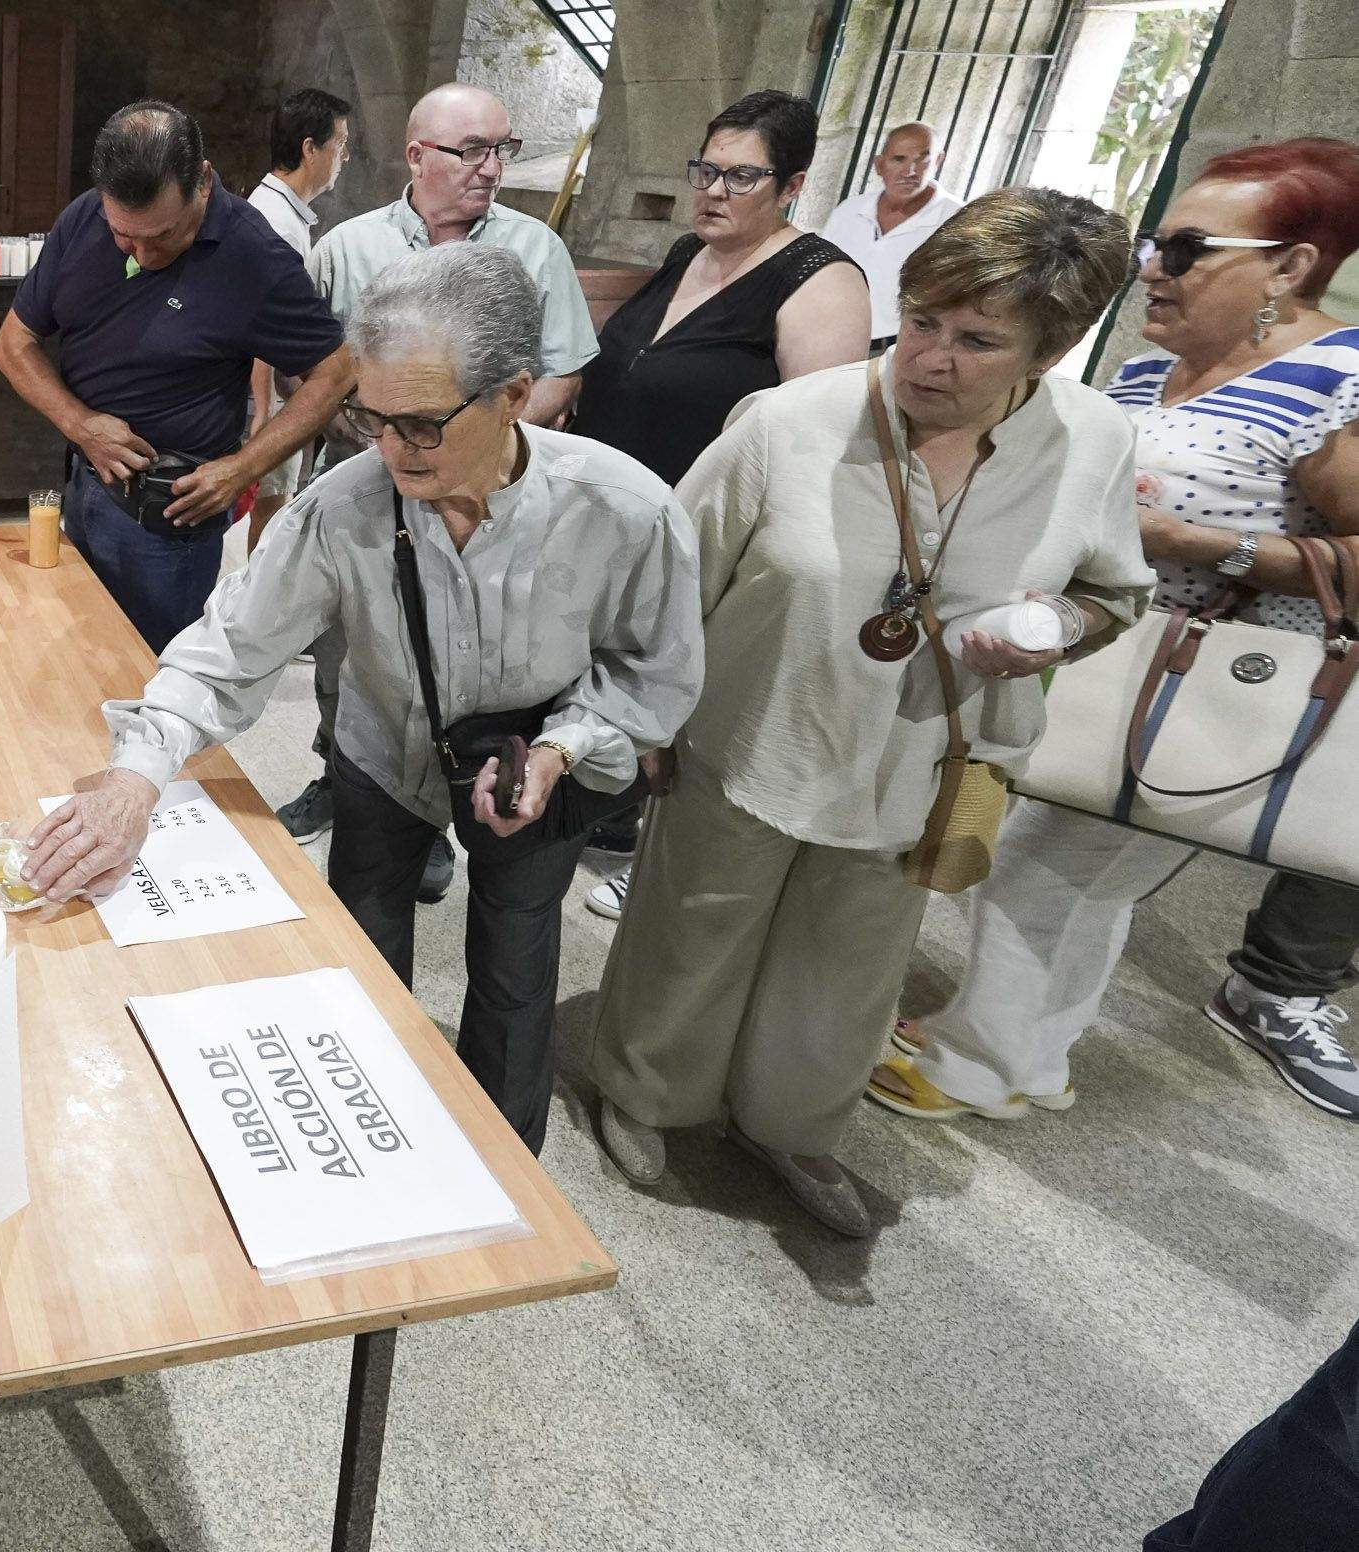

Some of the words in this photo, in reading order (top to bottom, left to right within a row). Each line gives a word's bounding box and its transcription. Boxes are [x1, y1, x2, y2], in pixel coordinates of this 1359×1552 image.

[169, 811, 185, 826] 7-8,4
[187, 807, 205, 823] 8-9,6
[172, 879, 194, 903] 1-1,20
[195, 878, 214, 898] 2-2,4
[215, 875, 235, 895] 3-3,6
[236, 872, 255, 891] 4-4,8
[137, 881, 169, 916] VELAS
[246, 1025, 287, 1060] DE
[199, 1045, 239, 1079] DE
[306, 1033, 401, 1152] GRACIAS
[221, 1087, 288, 1173] LIBRO
[268, 1067, 357, 1178] ACCIÓN
